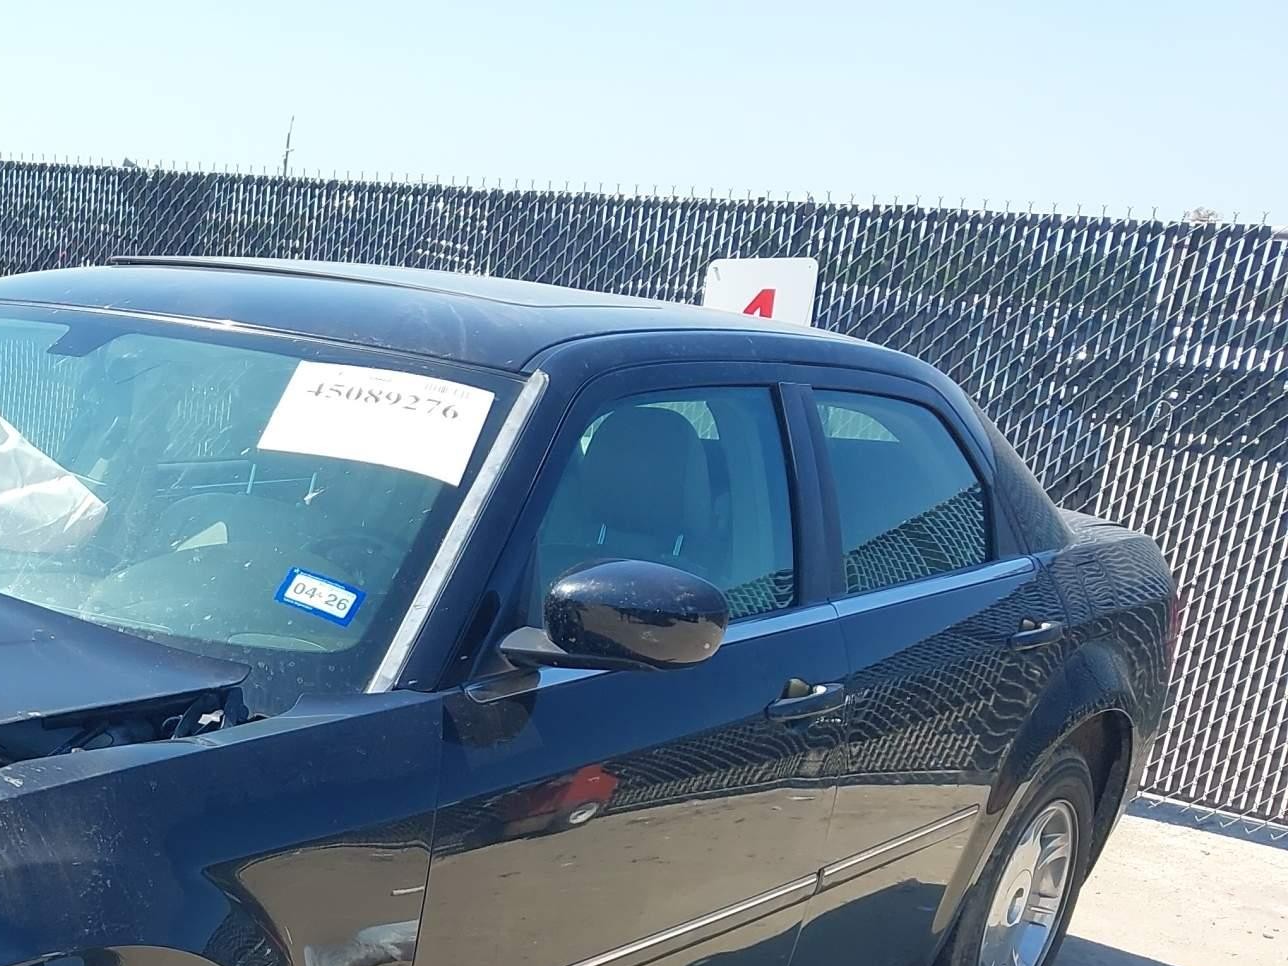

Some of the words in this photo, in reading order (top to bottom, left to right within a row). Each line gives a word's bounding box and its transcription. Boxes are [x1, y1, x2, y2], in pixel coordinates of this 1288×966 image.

[306, 383, 459, 419] 45089276
[293, 582, 318, 599] 04
[324, 593, 349, 611] 26
